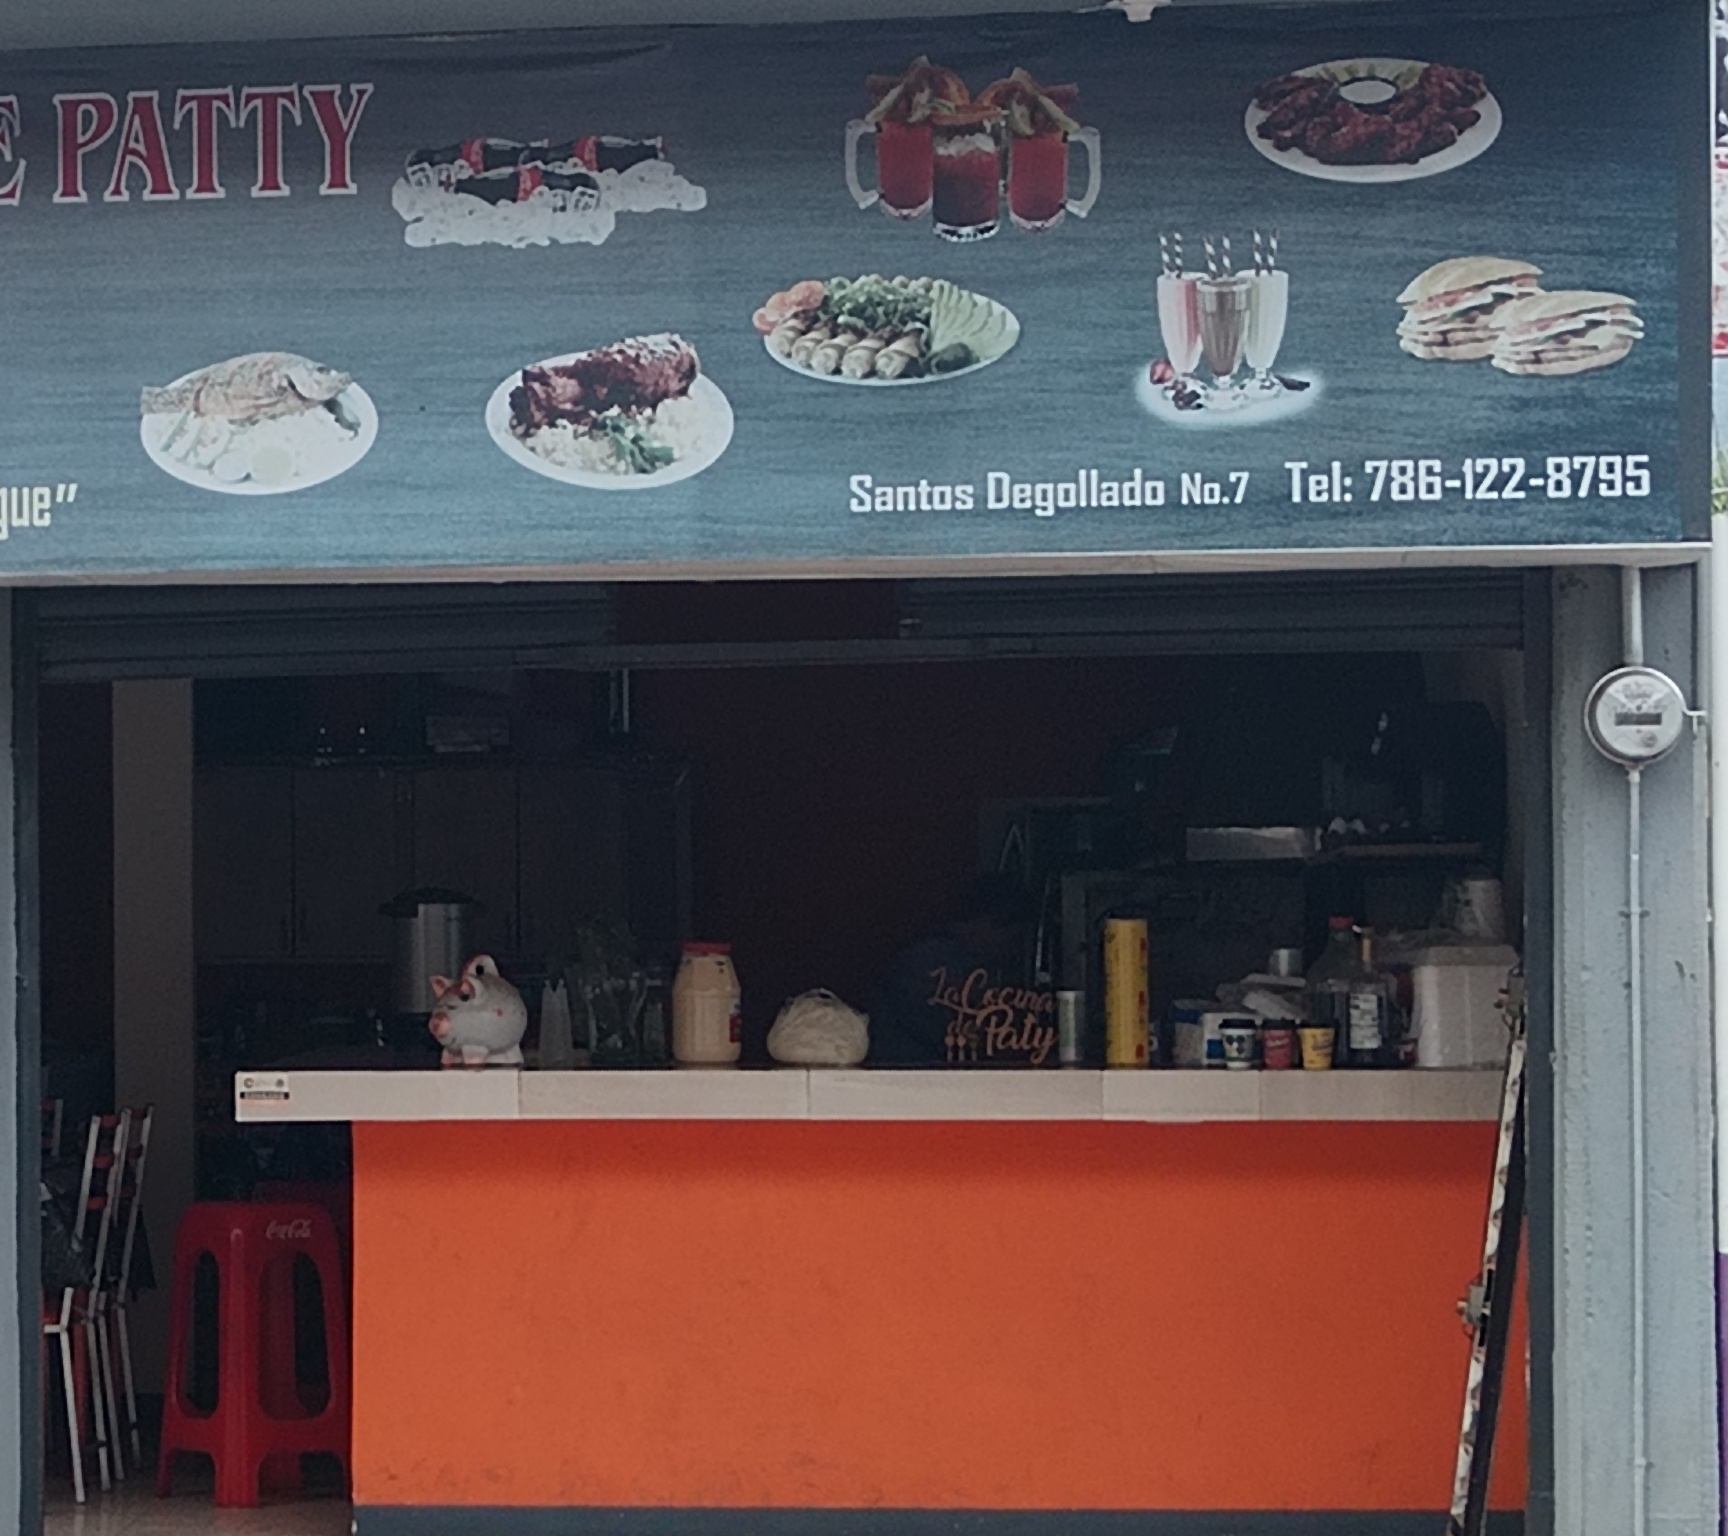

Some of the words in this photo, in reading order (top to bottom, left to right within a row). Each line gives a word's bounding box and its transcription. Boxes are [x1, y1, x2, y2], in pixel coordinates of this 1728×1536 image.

[52, 82, 374, 202] PATTY
[849, 473, 975, 514] Santos
[986, 467, 1166, 518] Degollado
[1179, 470, 1250, 506] No.7
[1283, 460, 1355, 504] Tel:
[1363, 453, 1651, 502] 786-122-8795
[928, 966, 960, 1006] La
[962, 968, 1054, 1013] Cocina
